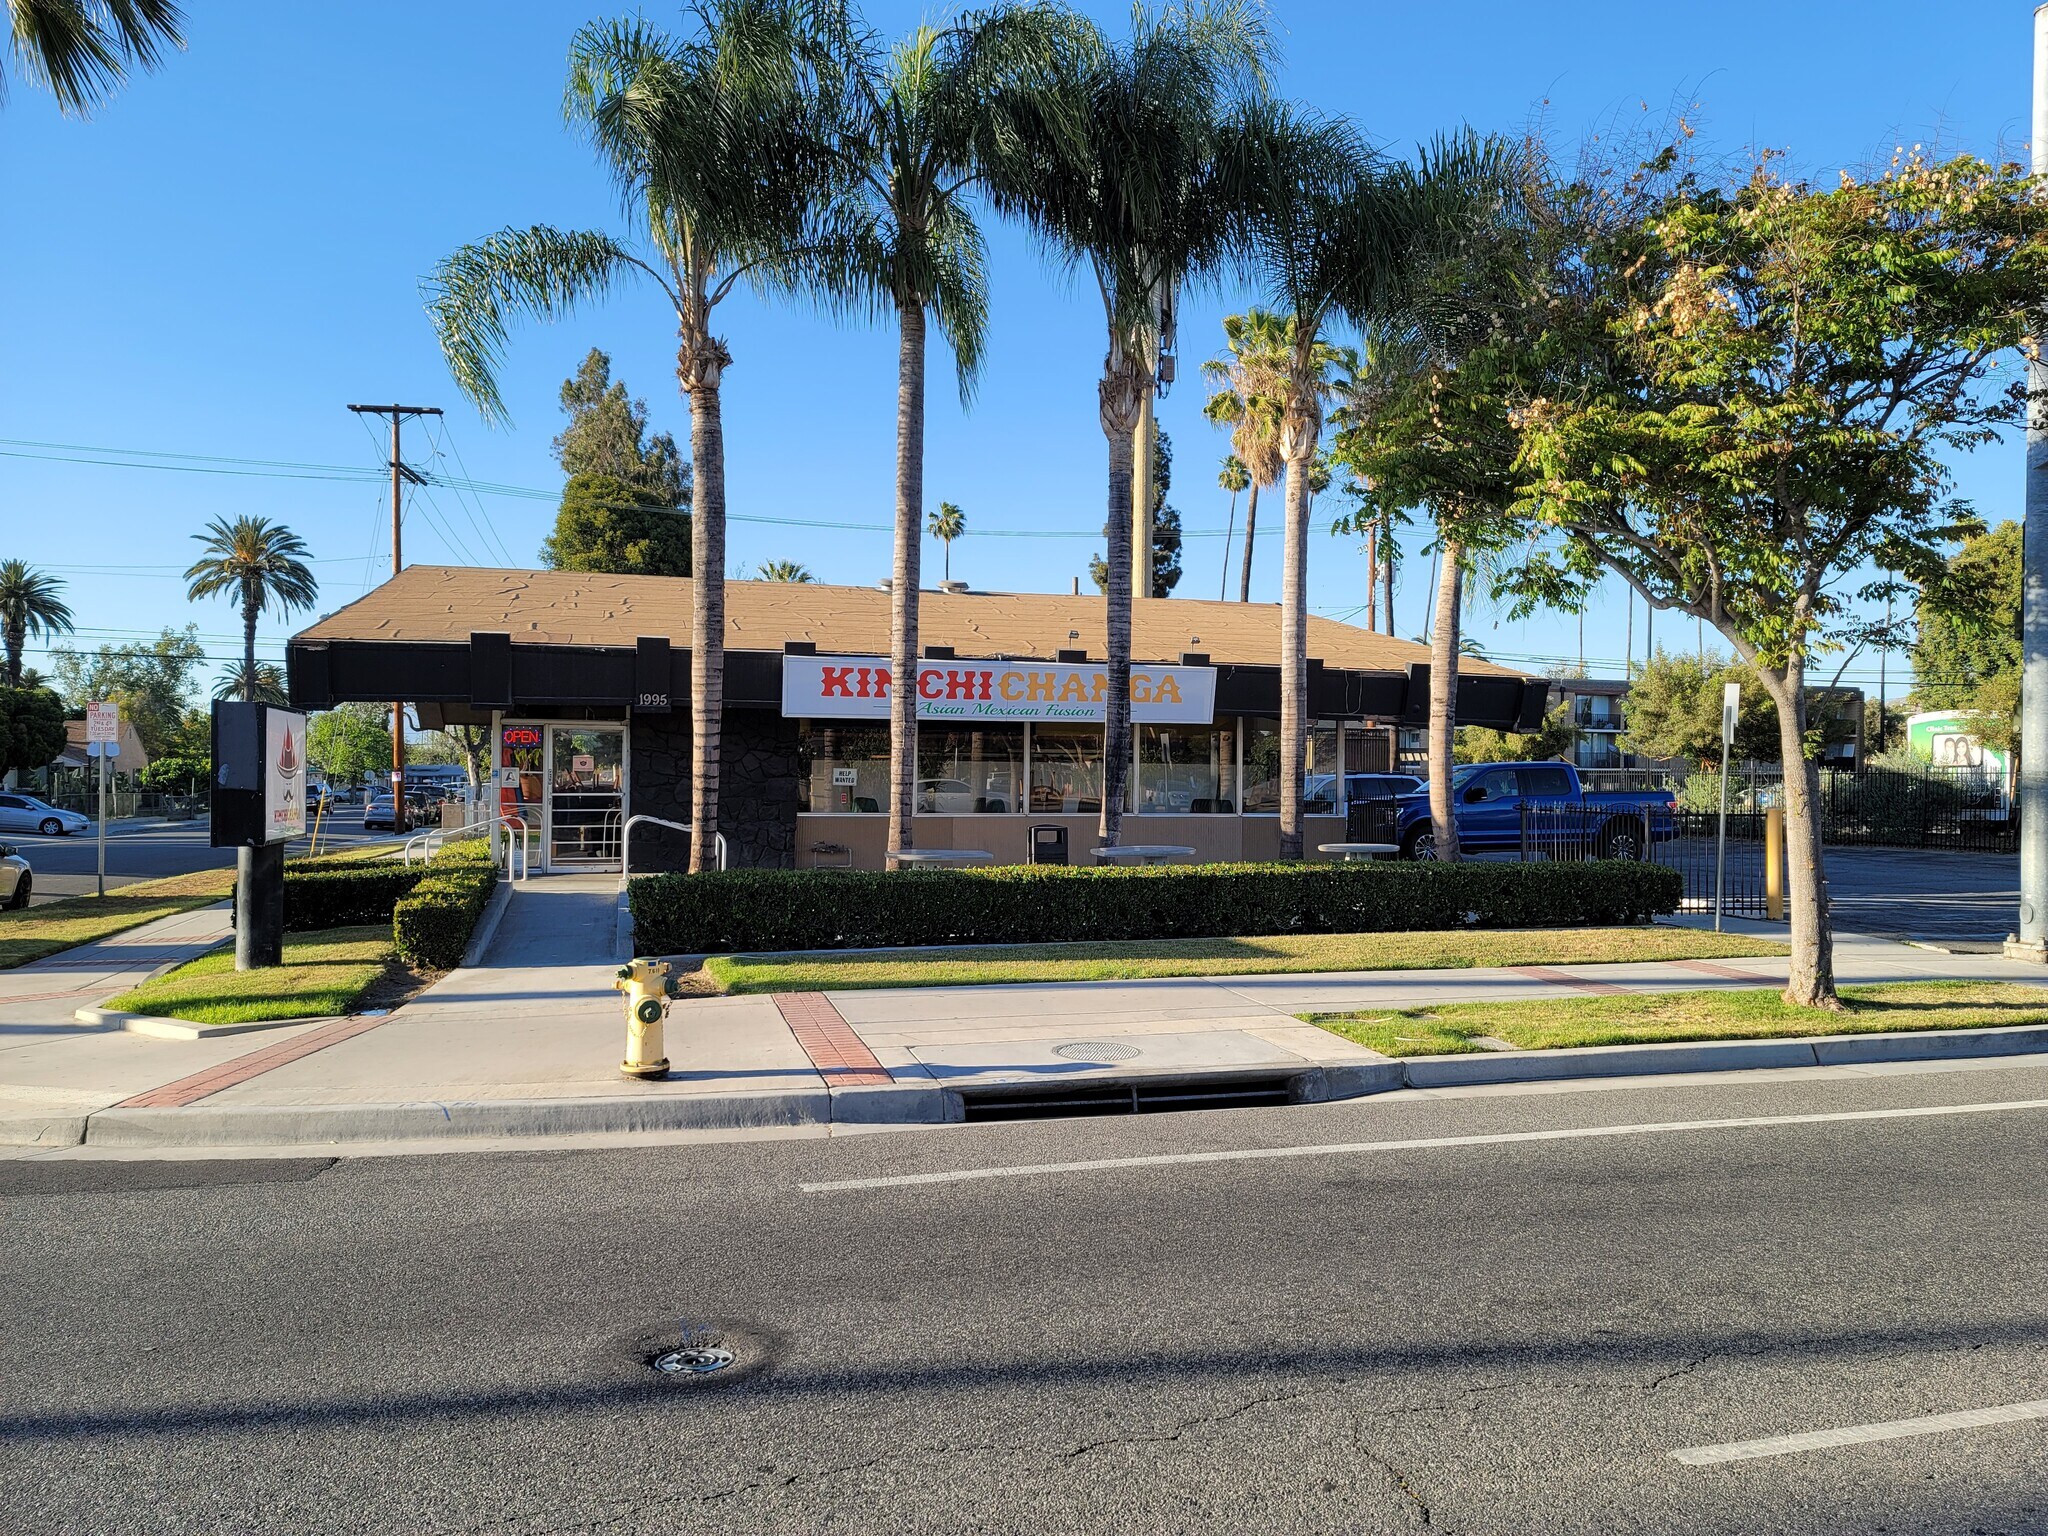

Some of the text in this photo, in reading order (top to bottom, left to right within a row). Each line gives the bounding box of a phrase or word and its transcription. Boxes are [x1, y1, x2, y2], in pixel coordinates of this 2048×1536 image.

[639, 693, 667, 706] 1995
[90, 711, 116, 719] PARKING
[916, 701, 1096, 717] Asian Mexican Fusion
[504, 730, 539, 743] OPEN
[505, 771, 516, 781] A
